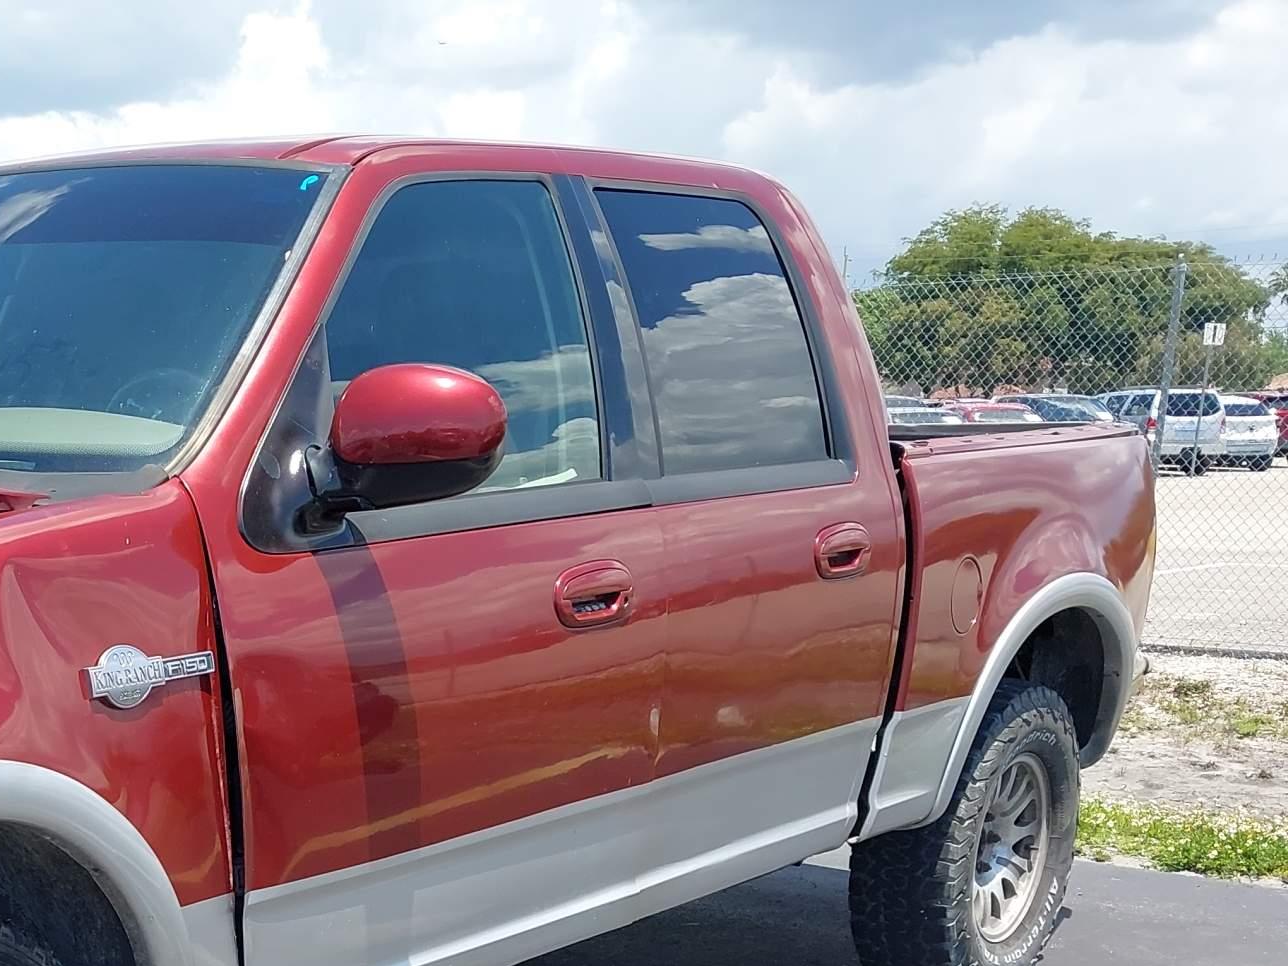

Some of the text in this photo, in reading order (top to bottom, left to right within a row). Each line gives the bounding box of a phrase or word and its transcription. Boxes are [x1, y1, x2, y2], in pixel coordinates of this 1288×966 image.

[93, 660, 163, 691] KING RANCH
[1003, 876, 1059, 964] All-Terrain
